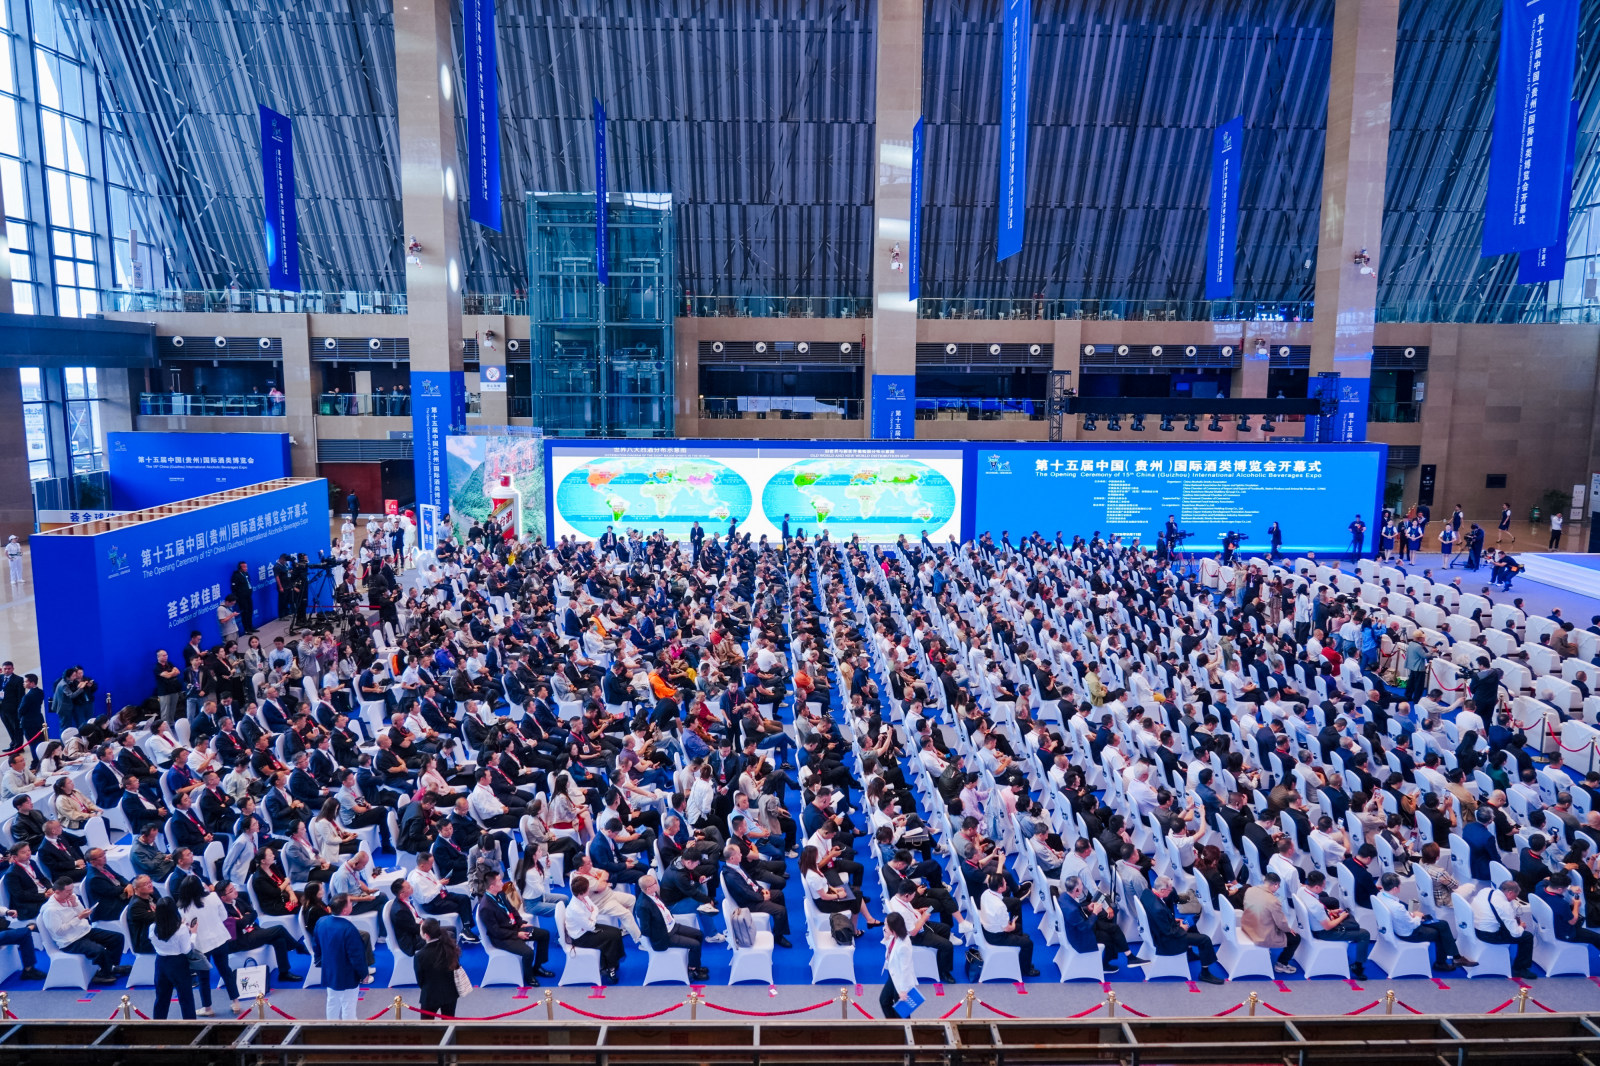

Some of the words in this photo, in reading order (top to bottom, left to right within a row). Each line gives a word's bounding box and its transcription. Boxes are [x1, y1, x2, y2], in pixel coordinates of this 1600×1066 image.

[1518, 13, 1545, 225] 第十五届中国(贵州)国际酒类博览会开幕式
[138, 456, 255, 464] 第十五届中国(贵州)国际酒类博览会
[1035, 459, 1322, 472] 第十五届中国(贵州)国际酒类博览会开幕式
[141, 502, 308, 568] 第十五届中国(贵州)国际酒类博览会开幕式
[143, 570, 153, 579] The
[154, 563, 175, 576] Opening
[175, 555, 199, 568] Ceremony
[200, 552, 205, 560] of
[213, 545, 226, 555] China
[246, 530, 268, 544] International
[167, 583, 221, 619] 荟全球佳酿
[173, 614, 193, 627] Collection
[193, 612, 198, 620] of
